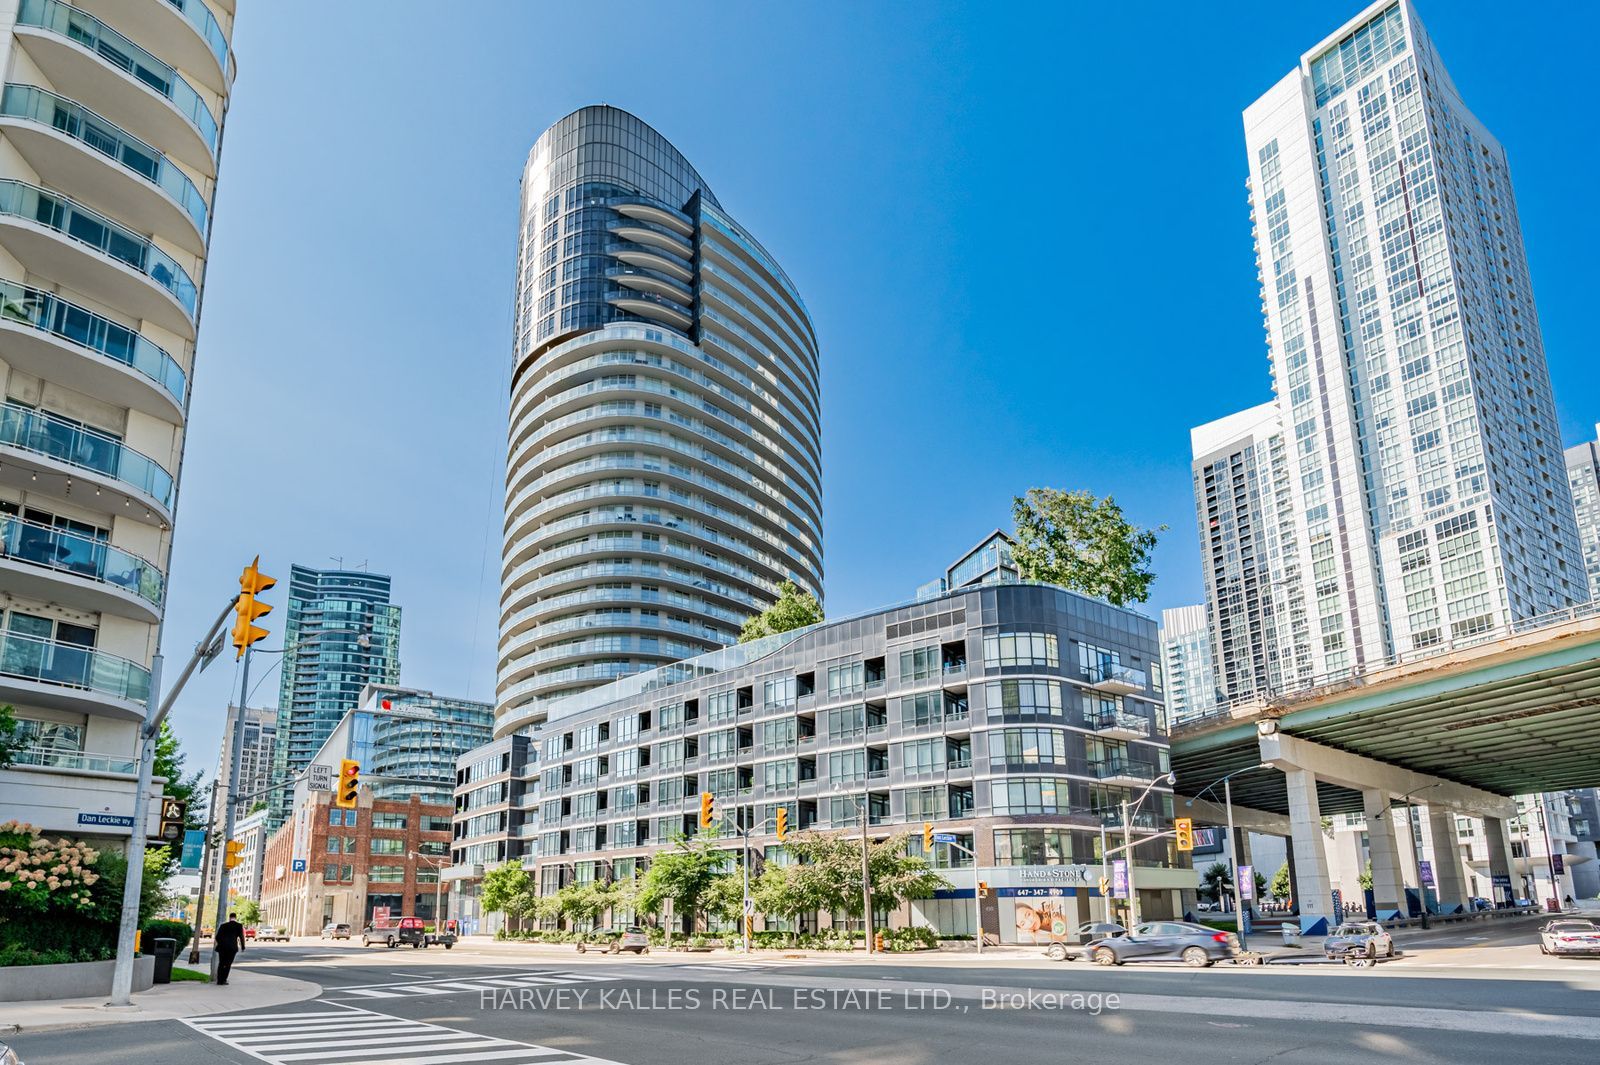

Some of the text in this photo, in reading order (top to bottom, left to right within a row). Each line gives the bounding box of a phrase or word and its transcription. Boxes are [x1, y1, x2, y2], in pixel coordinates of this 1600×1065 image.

[81, 814, 97, 822] Dan
[98, 816, 121, 824] Leckie
[295, 862, 303, 870] P
[1019, 870, 1046, 878] HAND
[1052, 869, 1081, 878] STONE
